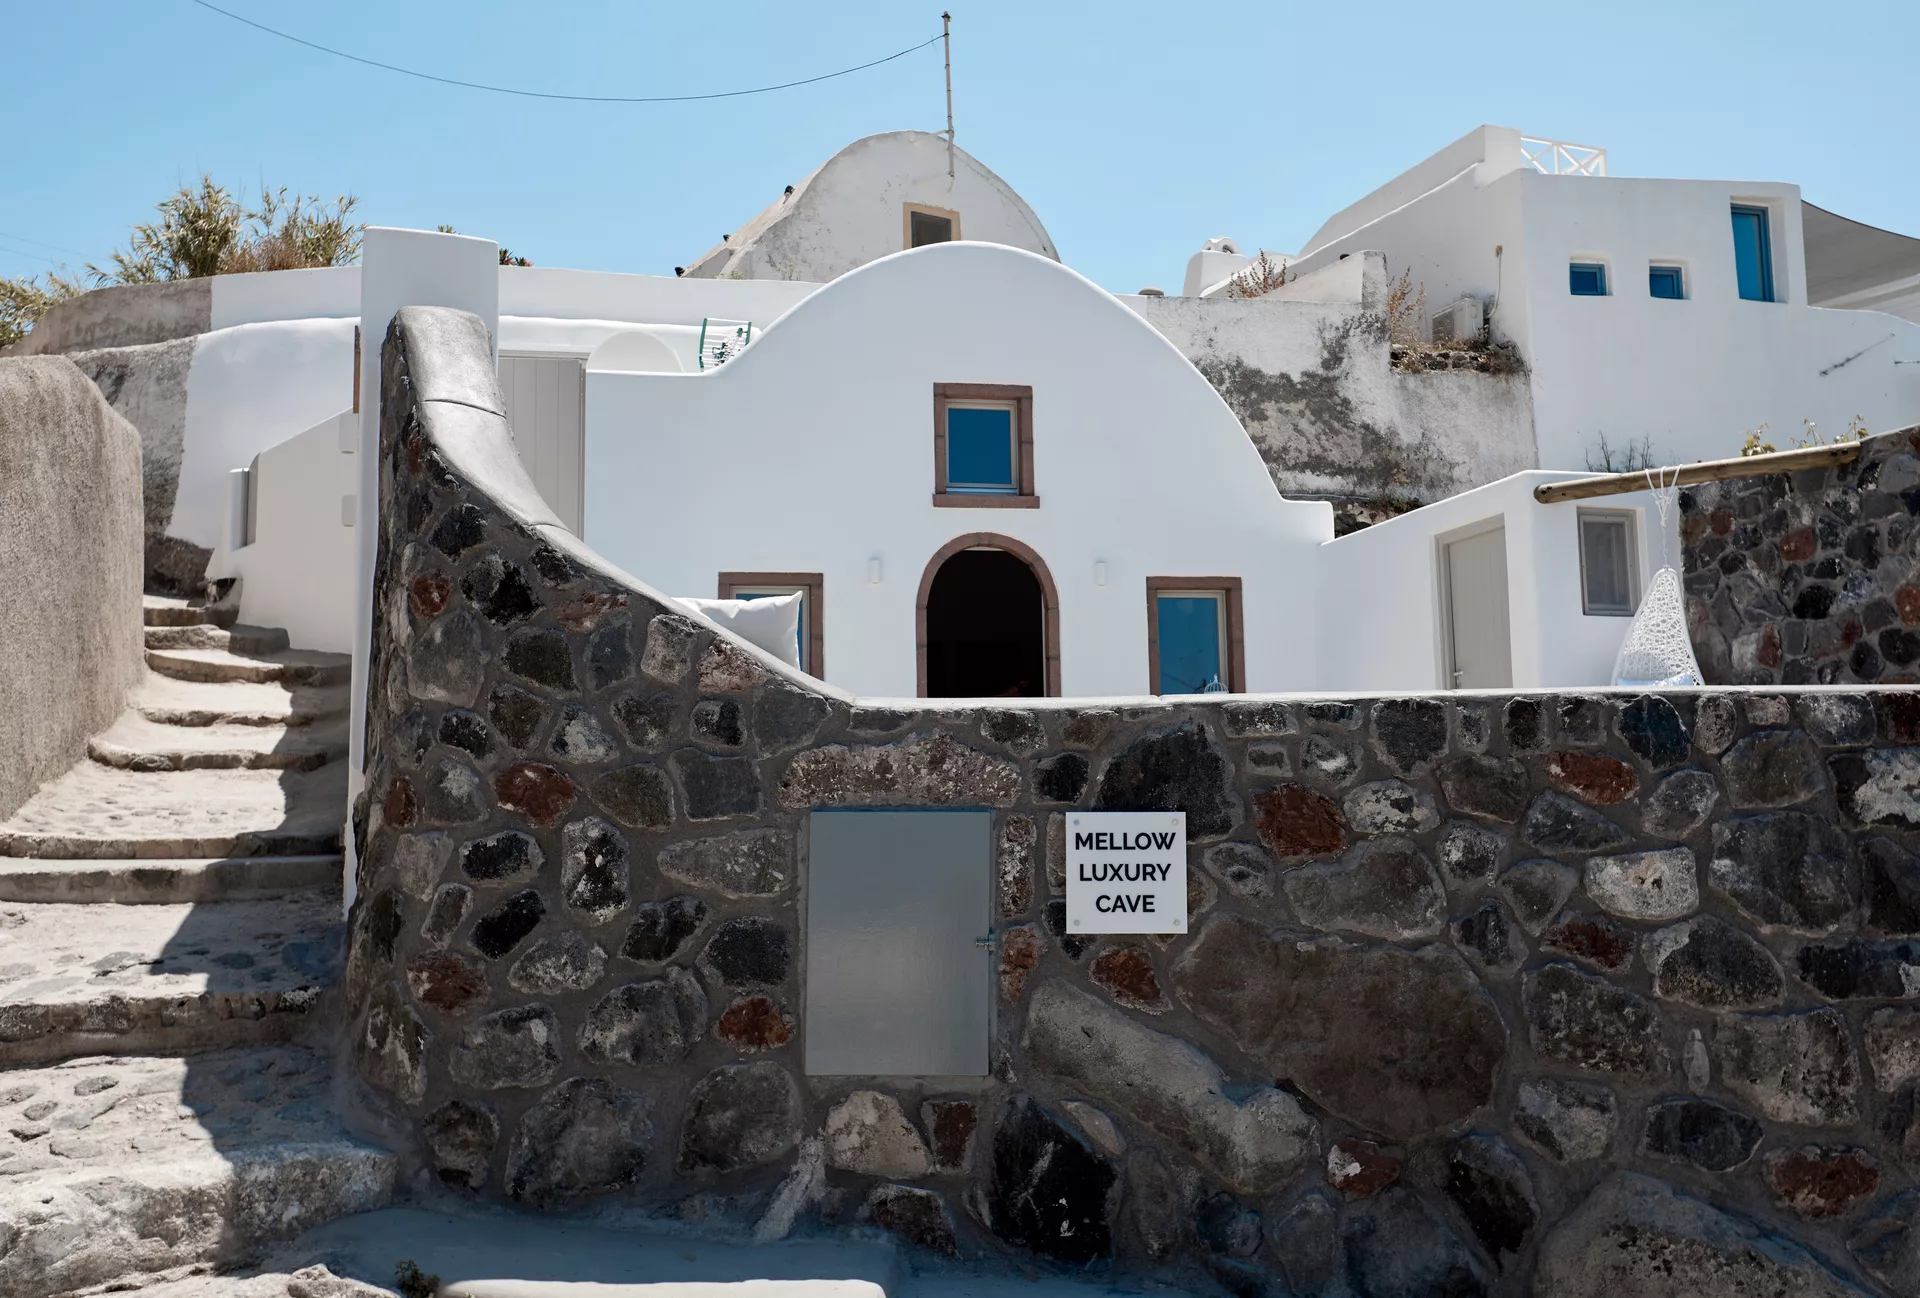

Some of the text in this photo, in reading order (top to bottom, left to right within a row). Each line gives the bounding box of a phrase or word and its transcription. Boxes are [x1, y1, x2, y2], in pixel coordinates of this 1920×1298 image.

[1075, 832, 1176, 851] MELLOW
[1079, 863, 1172, 882] LUXURY
[1095, 894, 1156, 913] CAVE
